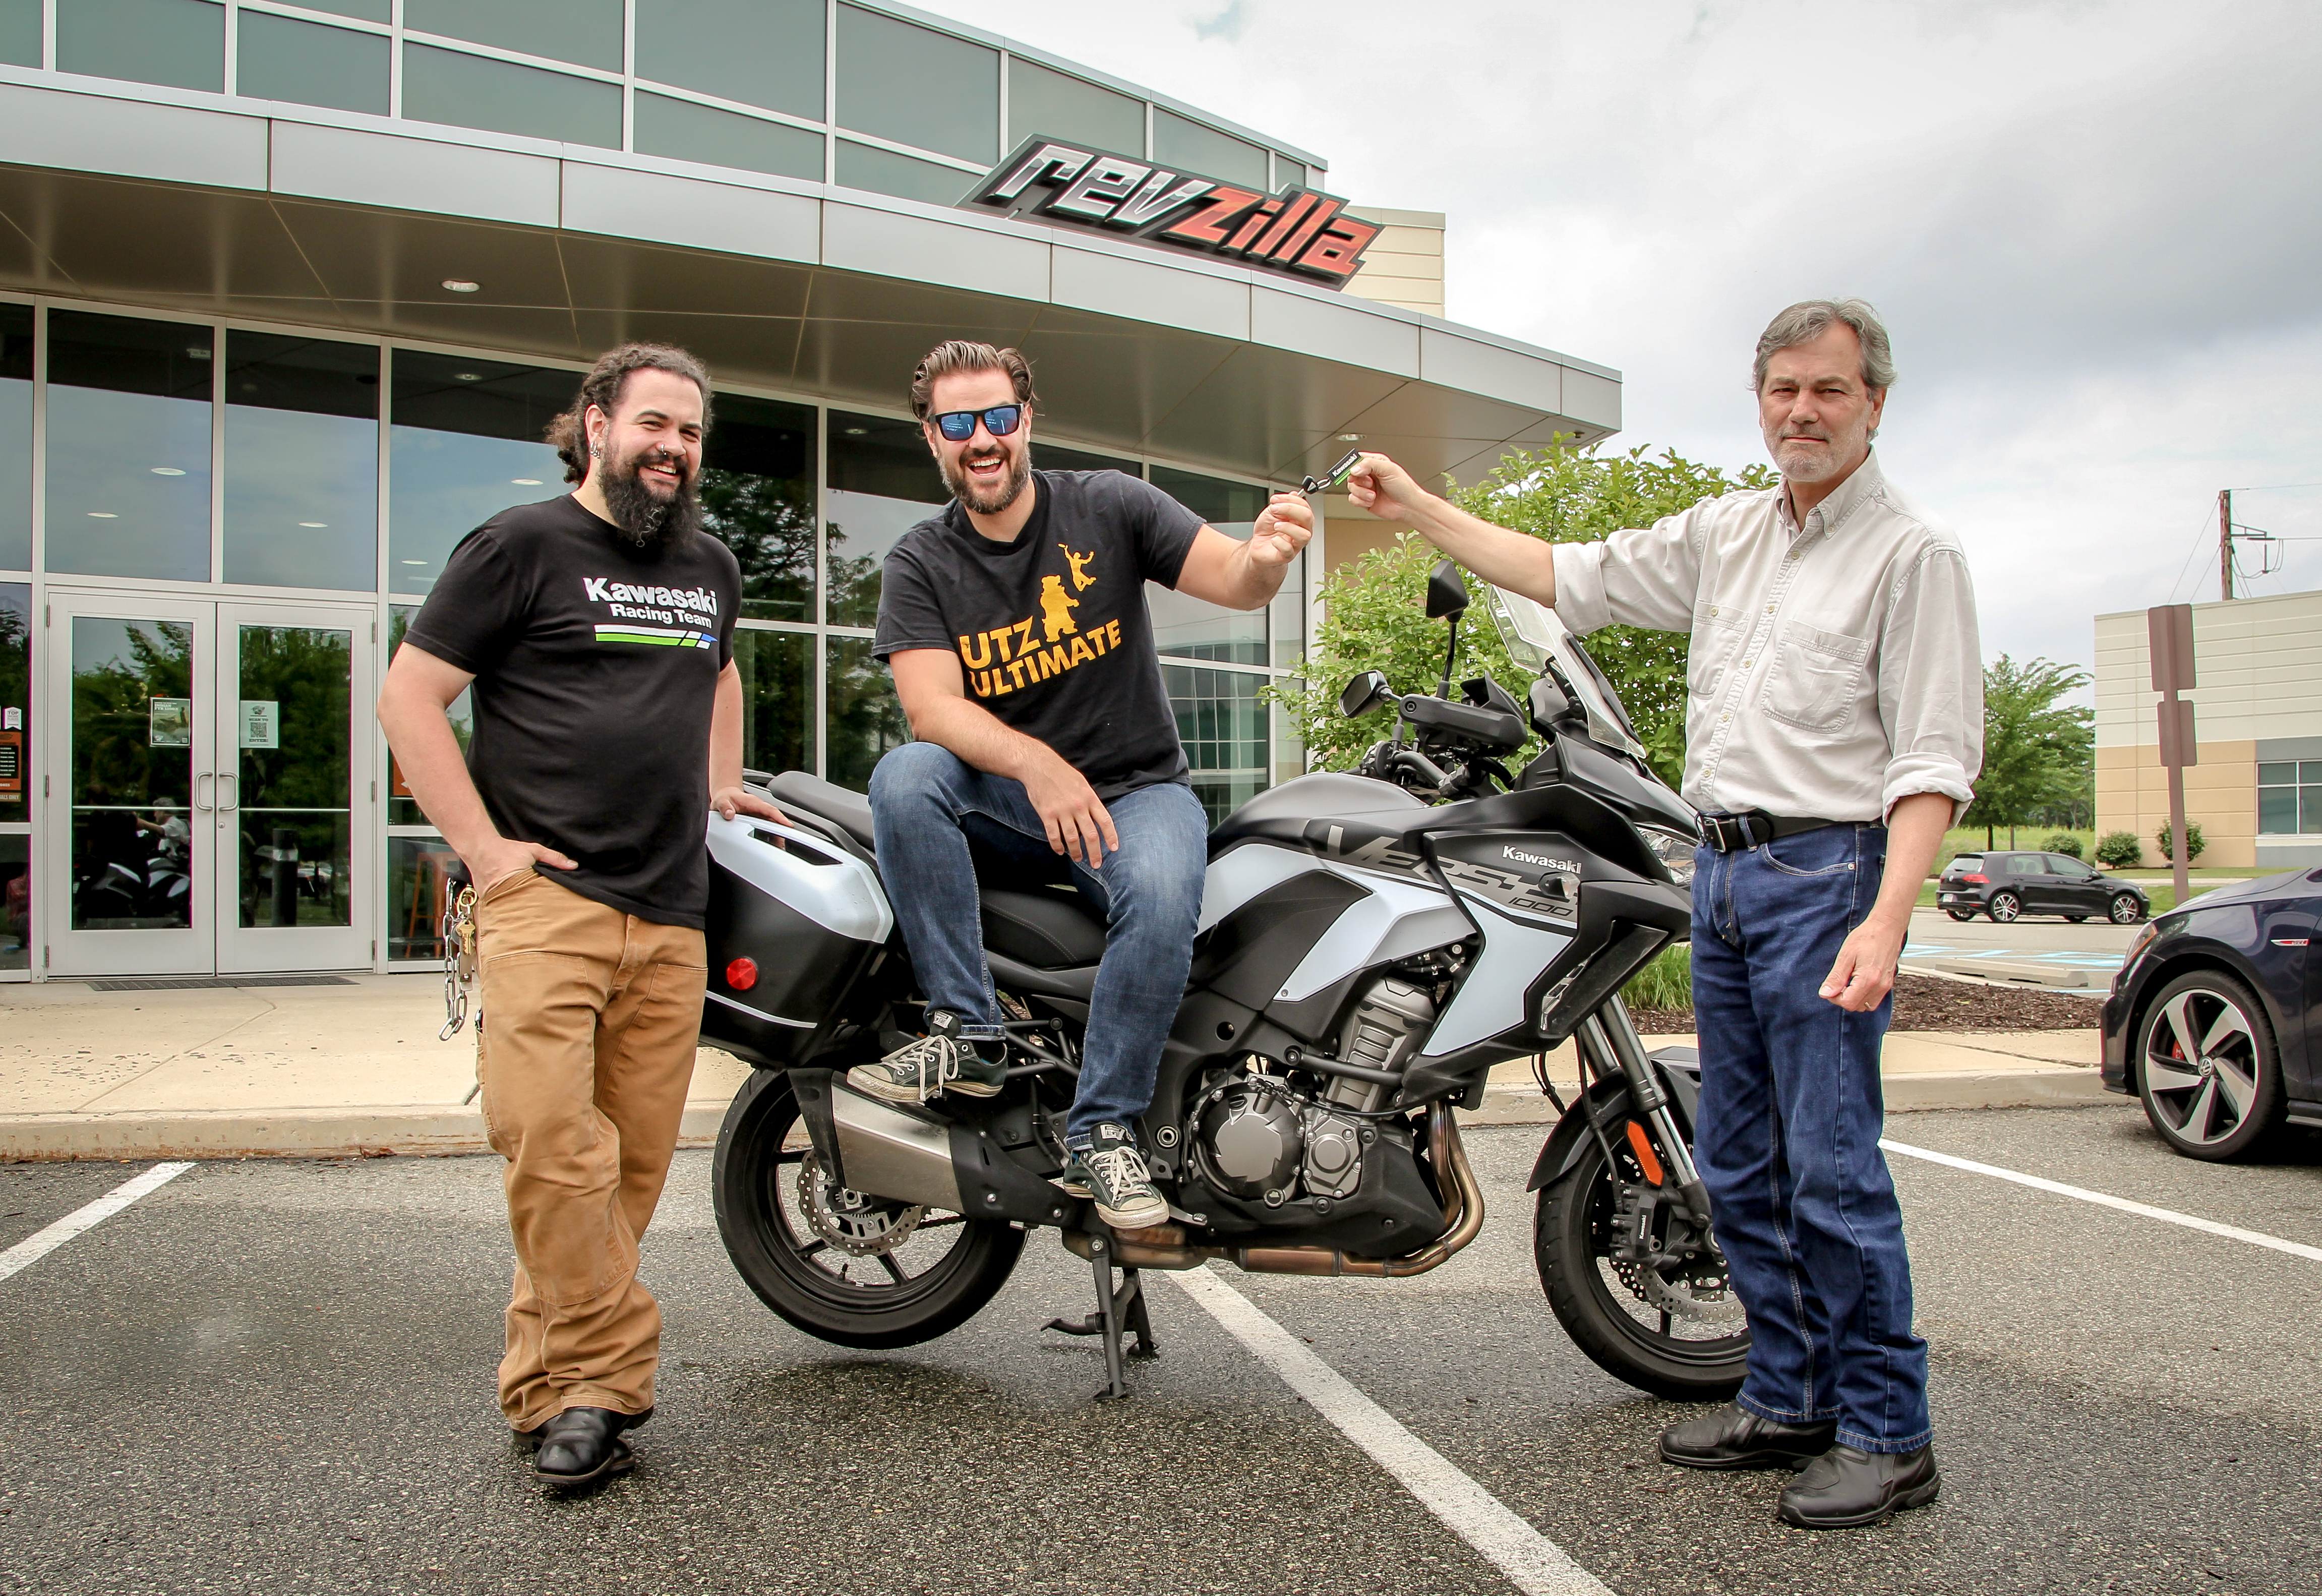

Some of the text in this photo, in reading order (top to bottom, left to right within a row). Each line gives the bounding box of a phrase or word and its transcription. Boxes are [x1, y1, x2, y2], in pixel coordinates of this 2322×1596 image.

[1332, 453, 1357, 477] Kawasaki
[582, 576, 718, 616] Kawasaki
[609, 603, 712, 629] Racing Team
[959, 615, 1041, 669] UTZ
[969, 618, 1121, 697] ULTIMATE
[1502, 845, 1582, 874] Kawasaki
[1508, 897, 1574, 917] 1000
